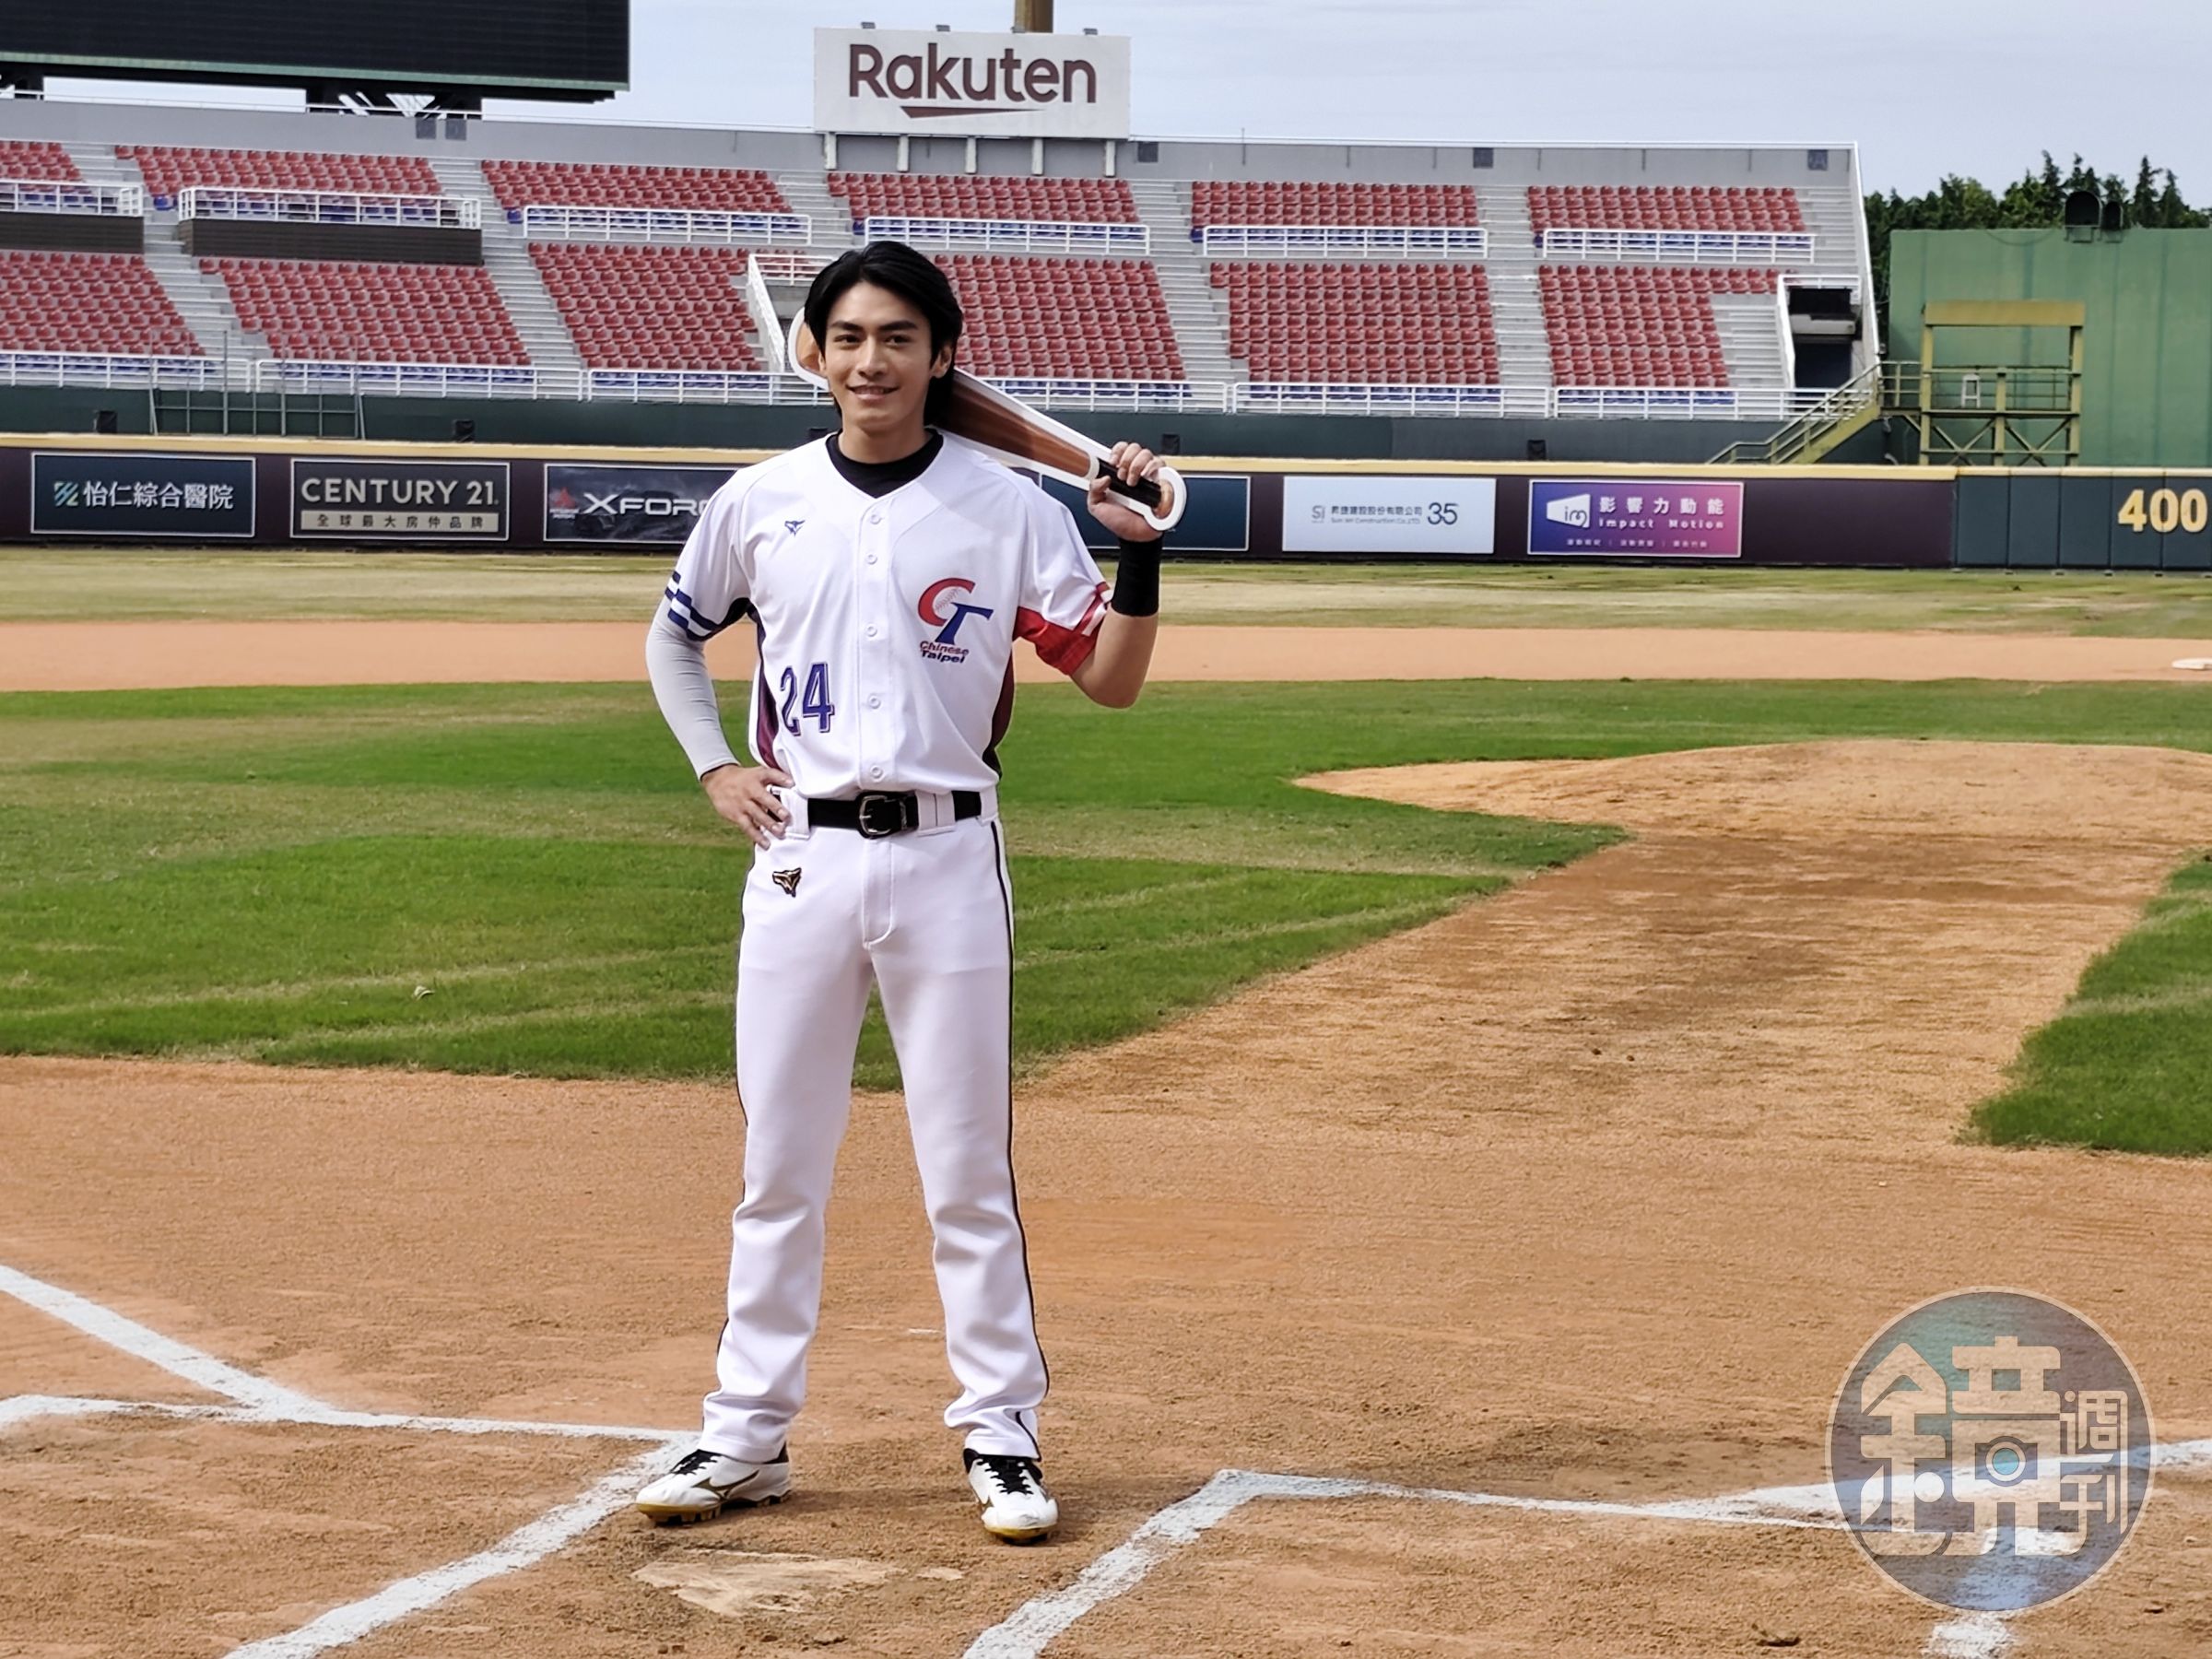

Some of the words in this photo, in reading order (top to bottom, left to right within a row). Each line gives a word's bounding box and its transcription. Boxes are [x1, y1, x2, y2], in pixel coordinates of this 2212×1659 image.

[849, 42, 1097, 103] Rakuten
[83, 480, 234, 510] 怡仁綜合醫院
[301, 477, 458, 505] CENTURY
[1428, 502, 1460, 525] 35
[1599, 496, 1724, 515] 影響力動能
[2117, 488, 2208, 533] 400
[317, 513, 484, 529] 全球最大房仲品牌
[1599, 518, 1654, 530] Impact
[1668, 519, 1724, 529] Motion
[920, 641, 970, 656] Chinese
[922, 651, 966, 664] Taipei
[780, 663, 835, 736] 24
